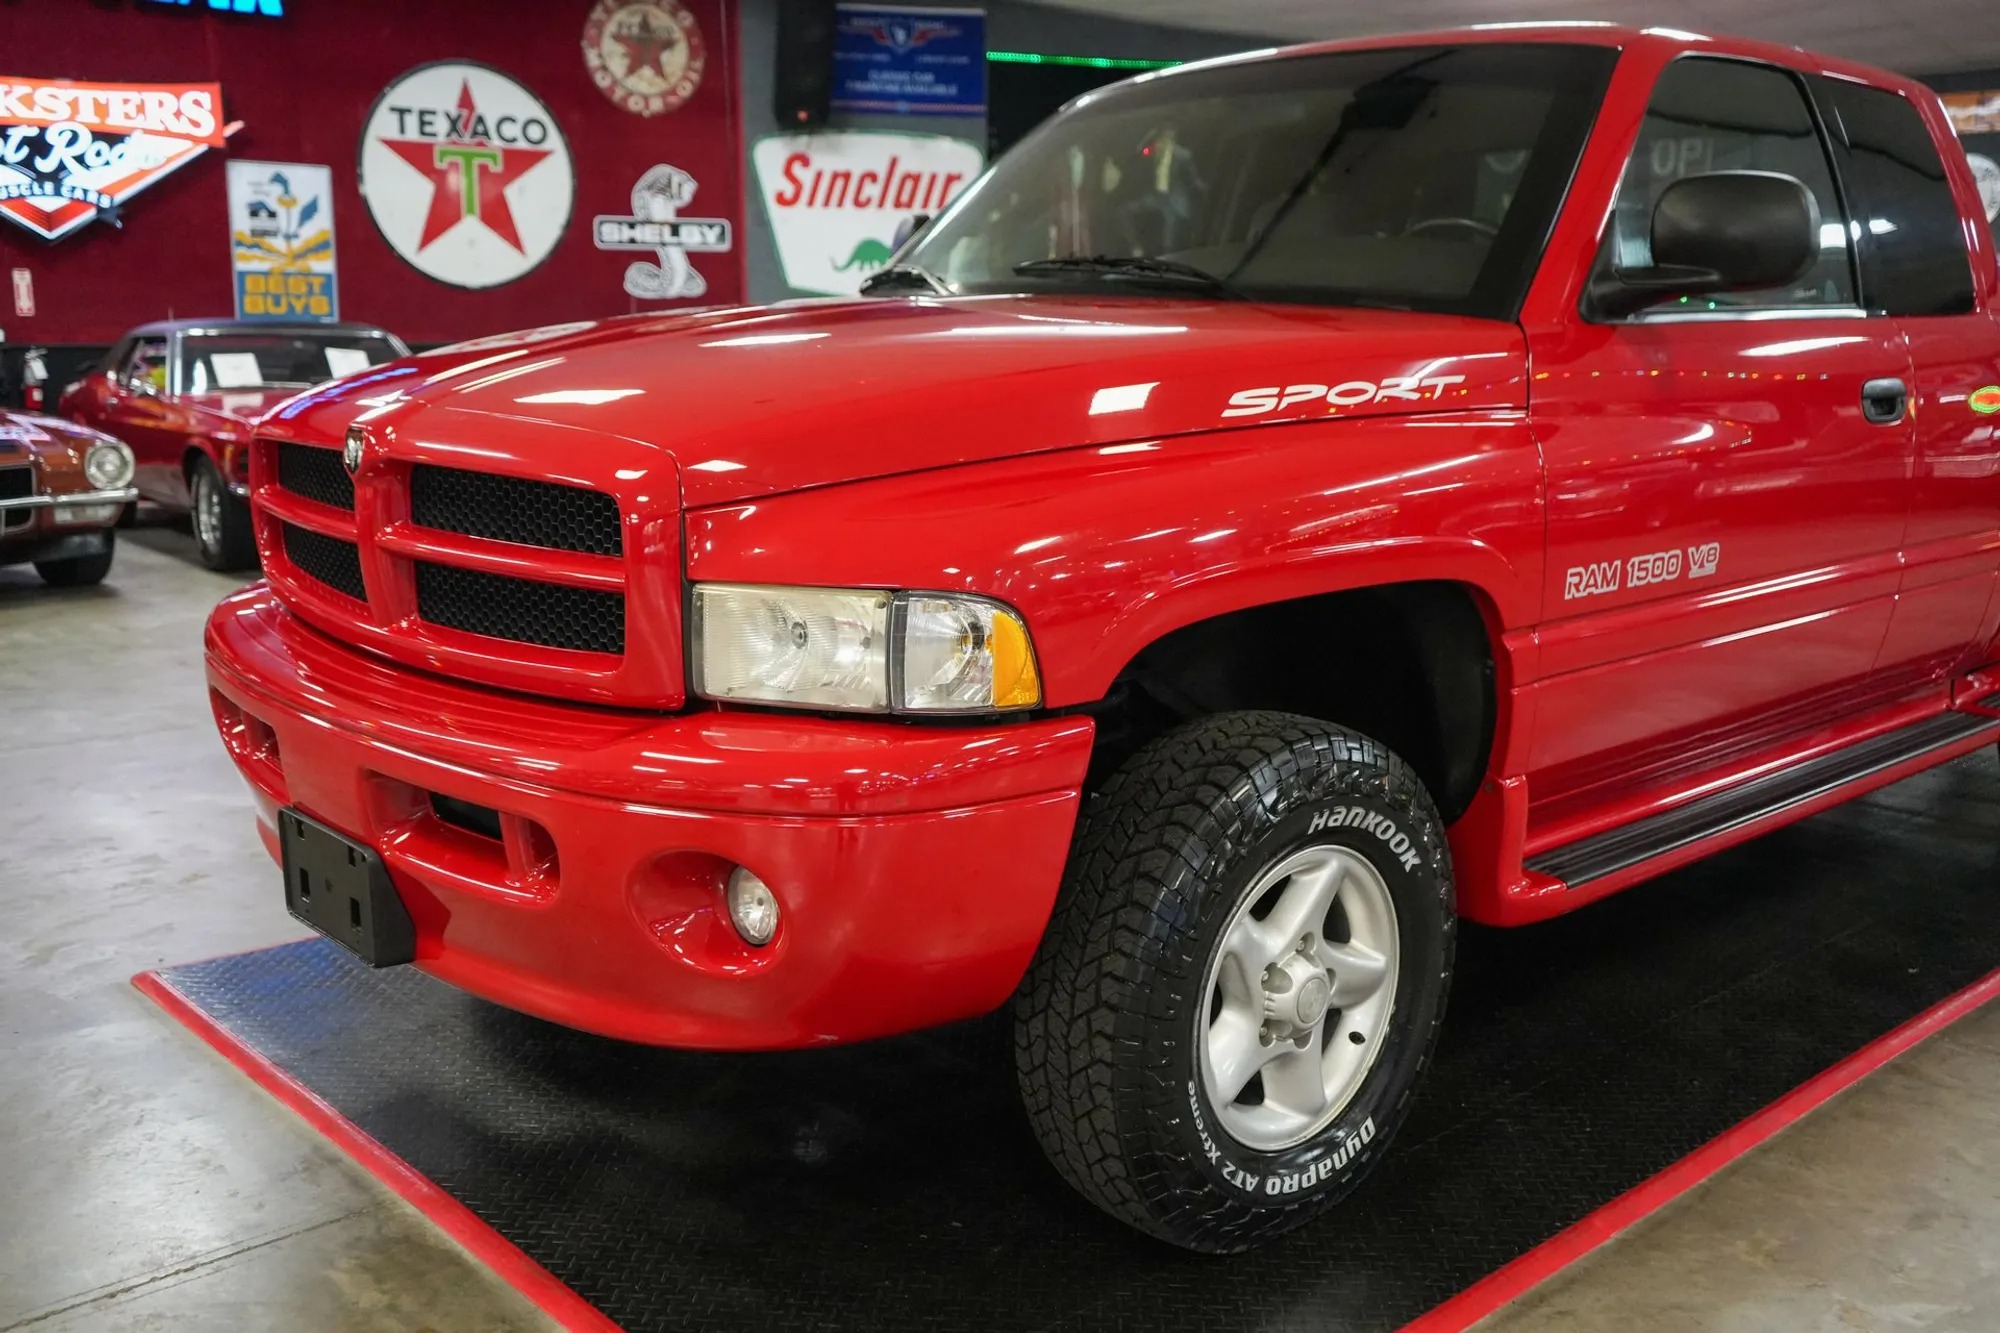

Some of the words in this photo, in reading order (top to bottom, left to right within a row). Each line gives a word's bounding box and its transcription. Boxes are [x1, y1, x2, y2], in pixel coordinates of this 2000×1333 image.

[388, 106, 548, 145] TEXACO
[436, 146, 502, 217] T
[775, 152, 963, 210] Sinclair
[599, 221, 724, 244] SHELBY
[245, 273, 325, 295] BEST
[243, 294, 330, 316] BUYS
[1221, 375, 1466, 418] SPORT
[1564, 559, 1621, 600] RAM
[1627, 549, 1682, 588] 1500
[1688, 542, 1720, 579] V8
[1188, 1080, 1222, 1166] Xtreme
[1221, 1161, 1260, 1192] AT2
